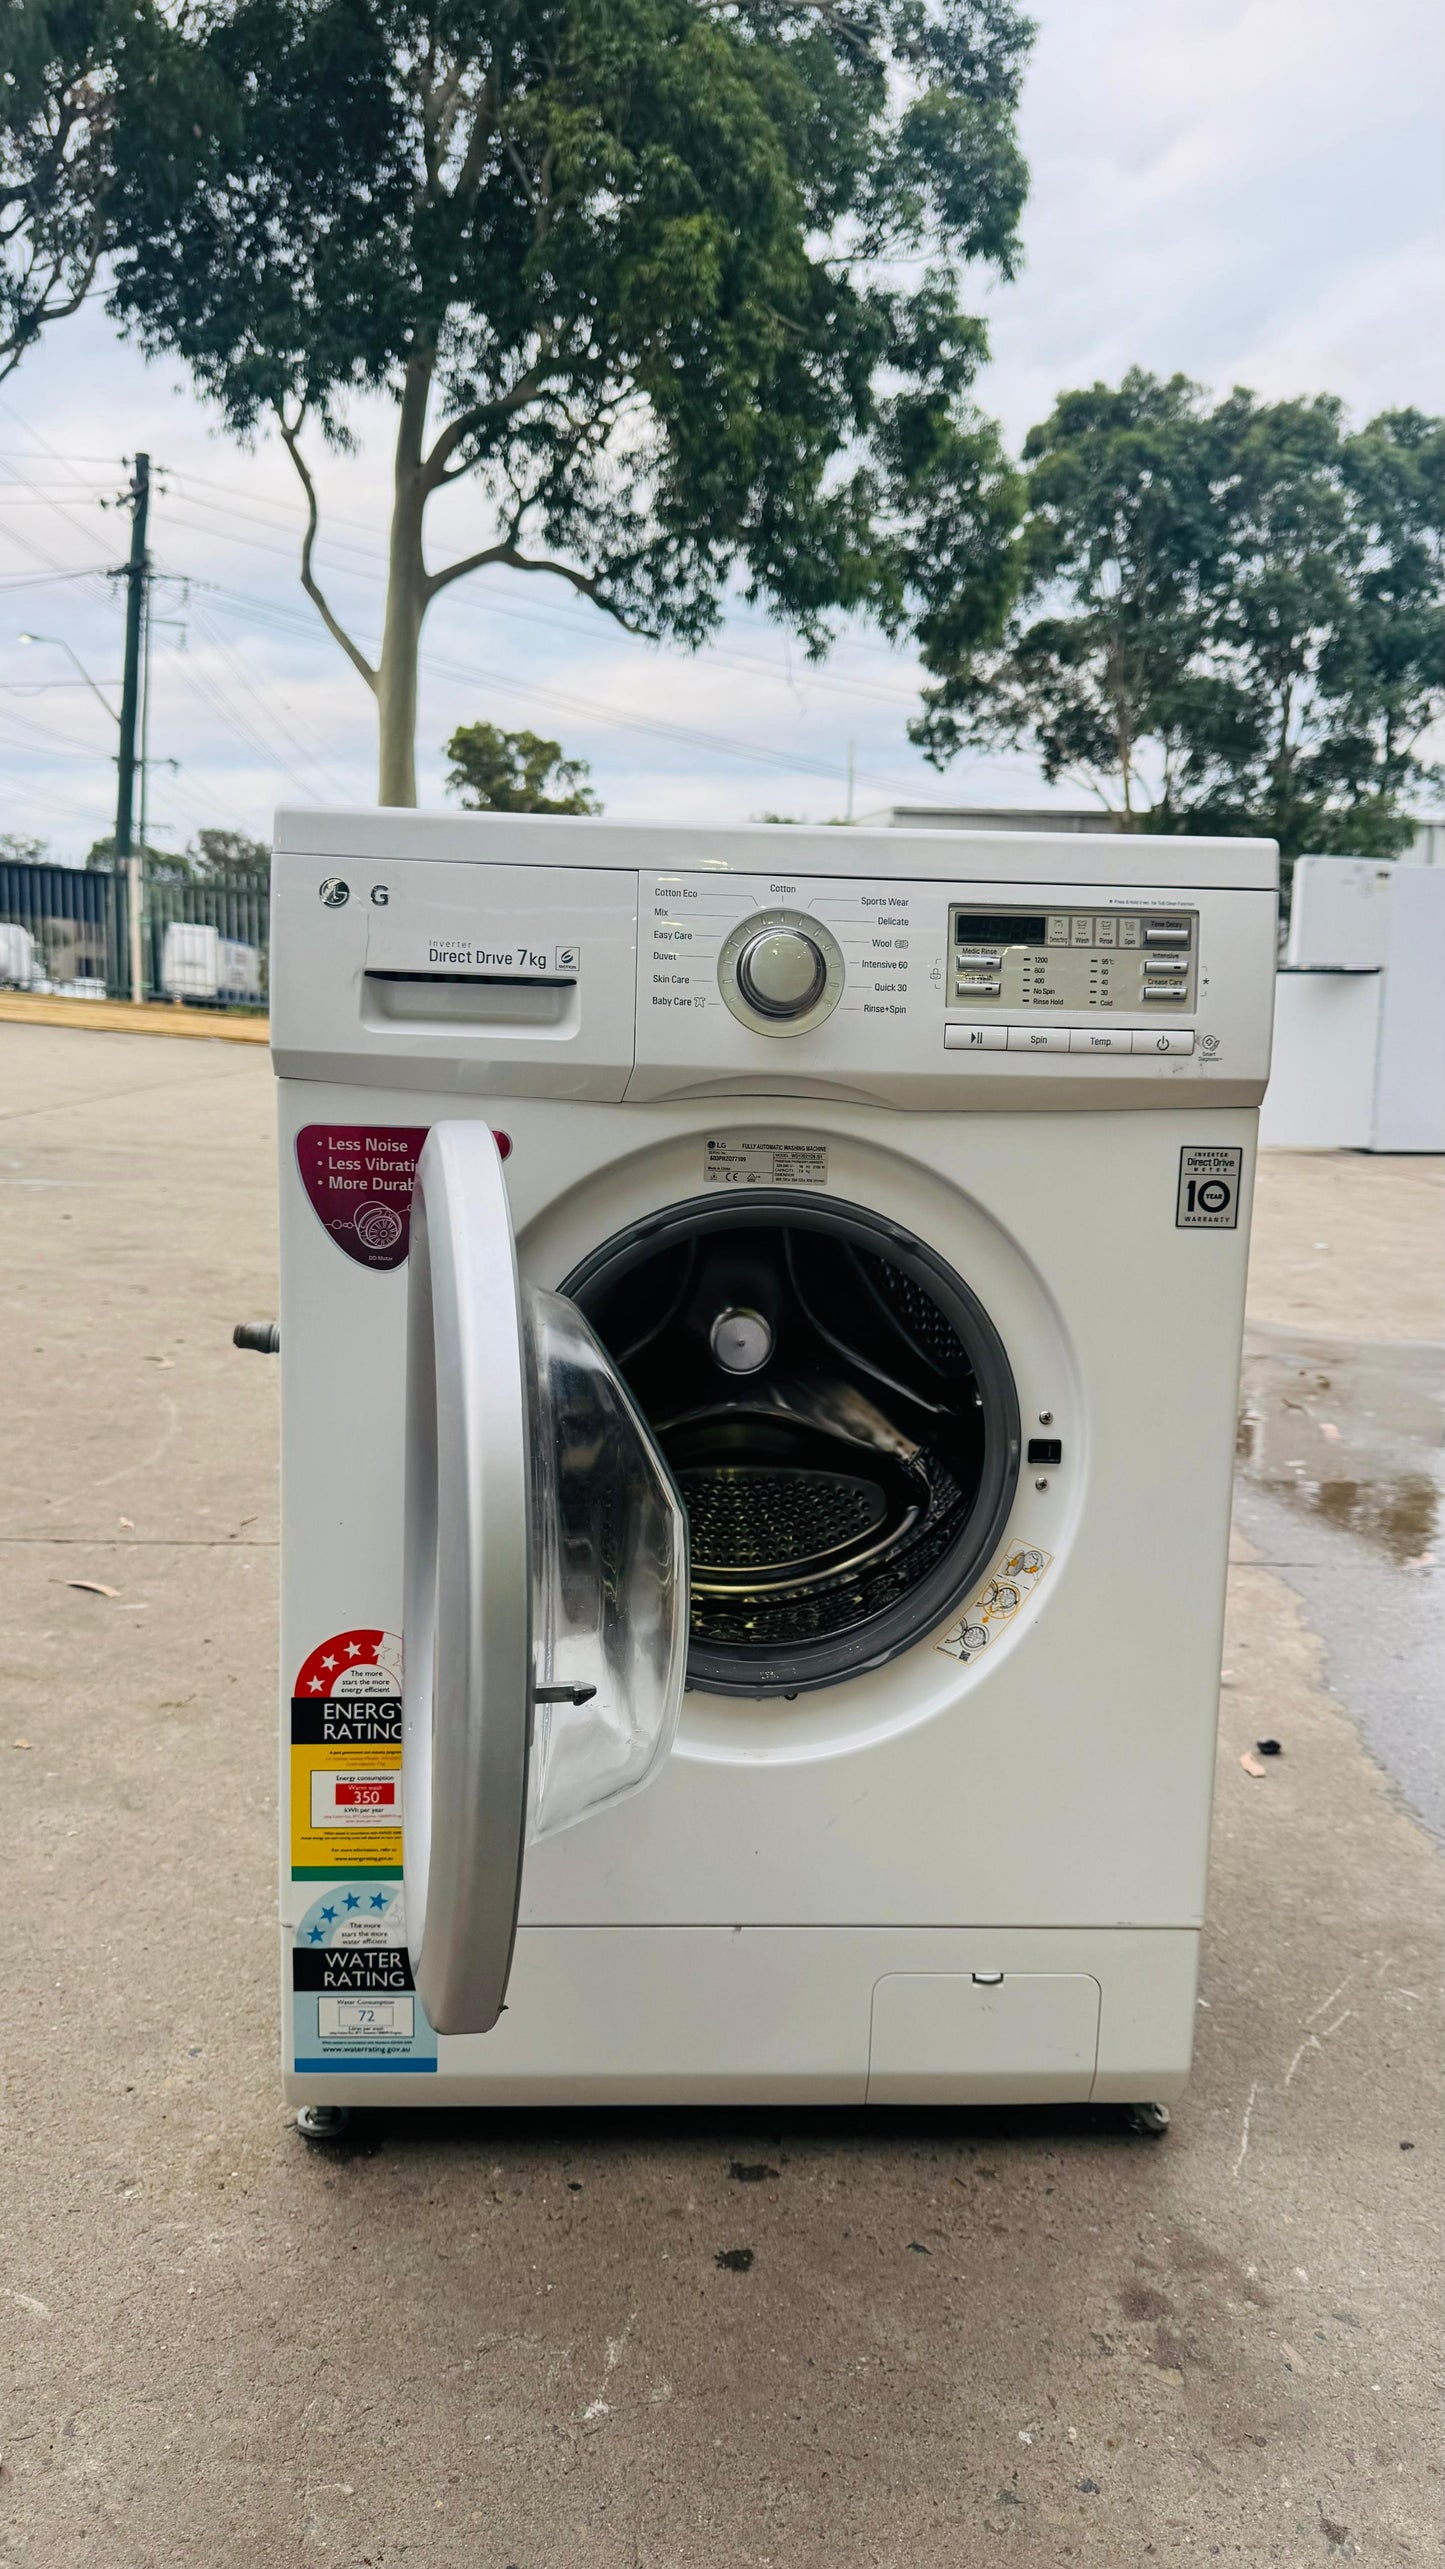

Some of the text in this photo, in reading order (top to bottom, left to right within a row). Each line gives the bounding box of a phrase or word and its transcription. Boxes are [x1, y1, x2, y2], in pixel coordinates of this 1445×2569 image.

[655, 888, 698, 898] Cotton Eco
[770, 884, 796, 893] Cotton
[371, 885, 389, 906] G
[861, 897, 909, 906] Sports Wear
[654, 908, 668, 916] Mix
[878, 917, 909, 926] Delicate
[1165, 921, 1183, 929] Delay
[654, 930, 692, 940] Easy Care
[429, 940, 471, 948] Inverter
[872, 939, 892, 948] Wool
[429, 948, 472, 964] Direct
[476, 950, 512, 965] Drive
[653, 952, 677, 960] Duvet
[862, 960, 908, 969] Intensive 60
[653, 975, 690, 984] Skin Care
[874, 983, 907, 992] Quick 30
[1043, 988, 1055, 996] Spin
[652, 996, 692, 1006] Baby Care
[864, 1004, 906, 1014] Rinse+Spin
[1030, 1036, 1048, 1045] Spin
[1091, 1037, 1113, 1047] Temp.
[329, 1137, 408, 1152] Less Noise
[329, 1157, 417, 1172] Less Vibrati
[1187, 1158, 1235, 1167] Direct Drive
[329, 1176, 367, 1190] More
[1187, 1180, 1230, 1213] 10
[354, 1791, 380, 1803] 350
[325, 1952, 402, 1968] WATER
[324, 1971, 405, 1986] RATING
[359, 2010, 374, 2022] 72
[322, 2046, 410, 2054] www.waterrating.gov.au
